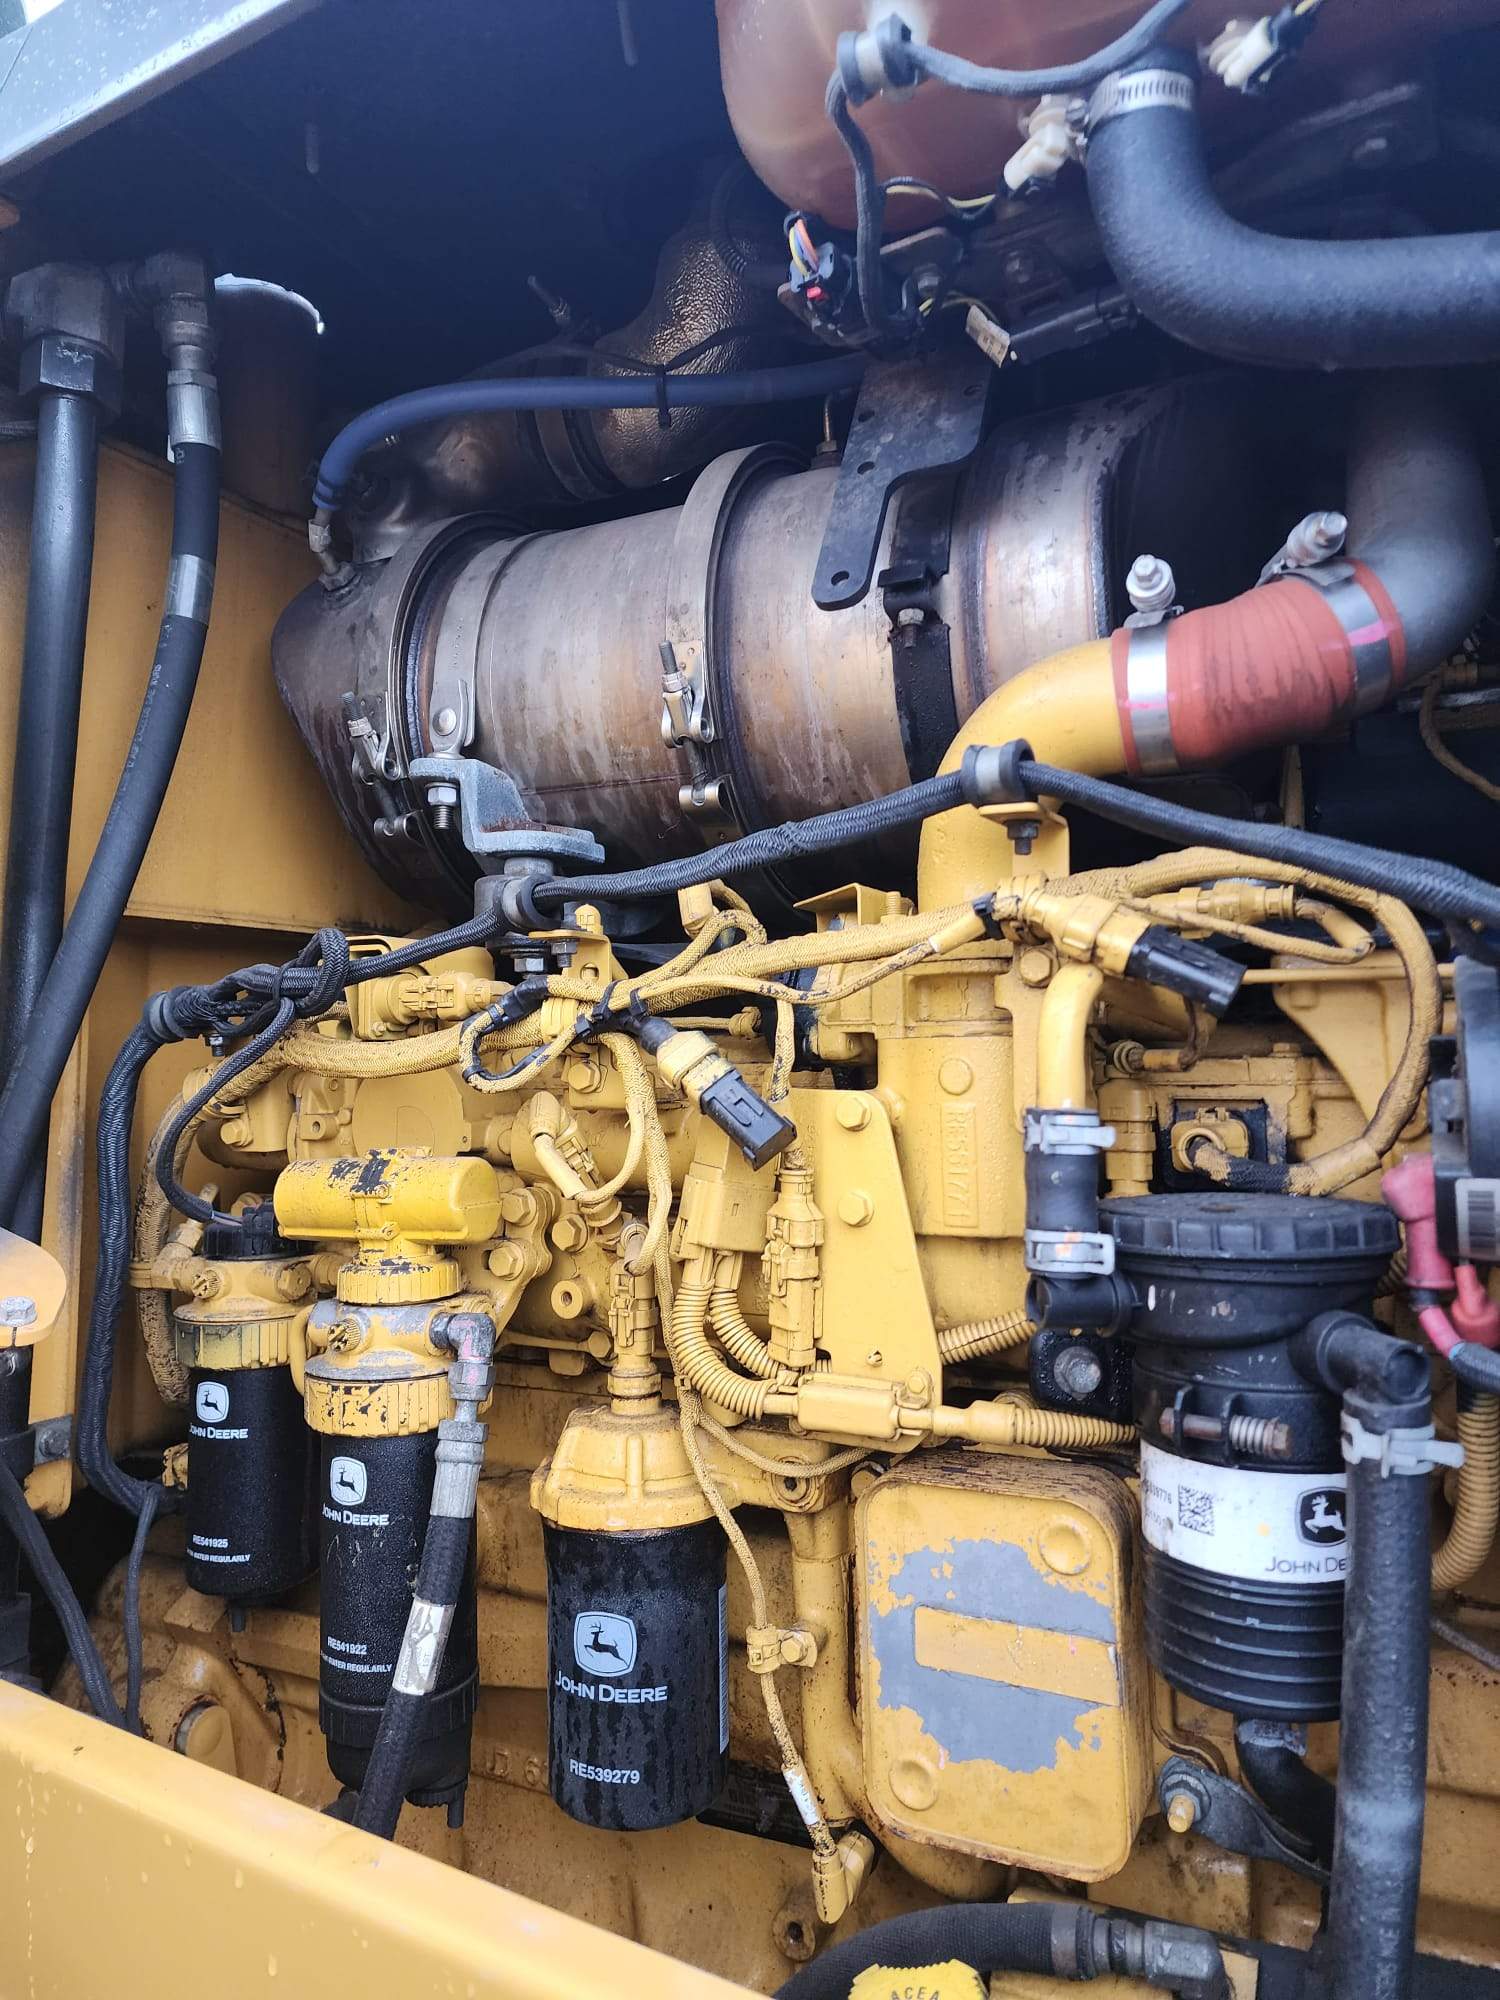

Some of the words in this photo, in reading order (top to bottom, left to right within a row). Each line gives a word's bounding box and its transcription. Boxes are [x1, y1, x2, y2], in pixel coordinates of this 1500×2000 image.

[207, 1426, 249, 1440] DEERE
[322, 1503, 342, 1522] JOHN
[342, 1510, 390, 1526] DEERE
[1265, 1555, 1321, 1574] JOHN
[327, 1636, 368, 1655] RE541922
[346, 1662, 393, 1673] REGULARLY
[555, 1670, 595, 1700] JOHN
[599, 1684, 669, 1704] DEERE
[569, 1758, 641, 1785] RE539279
